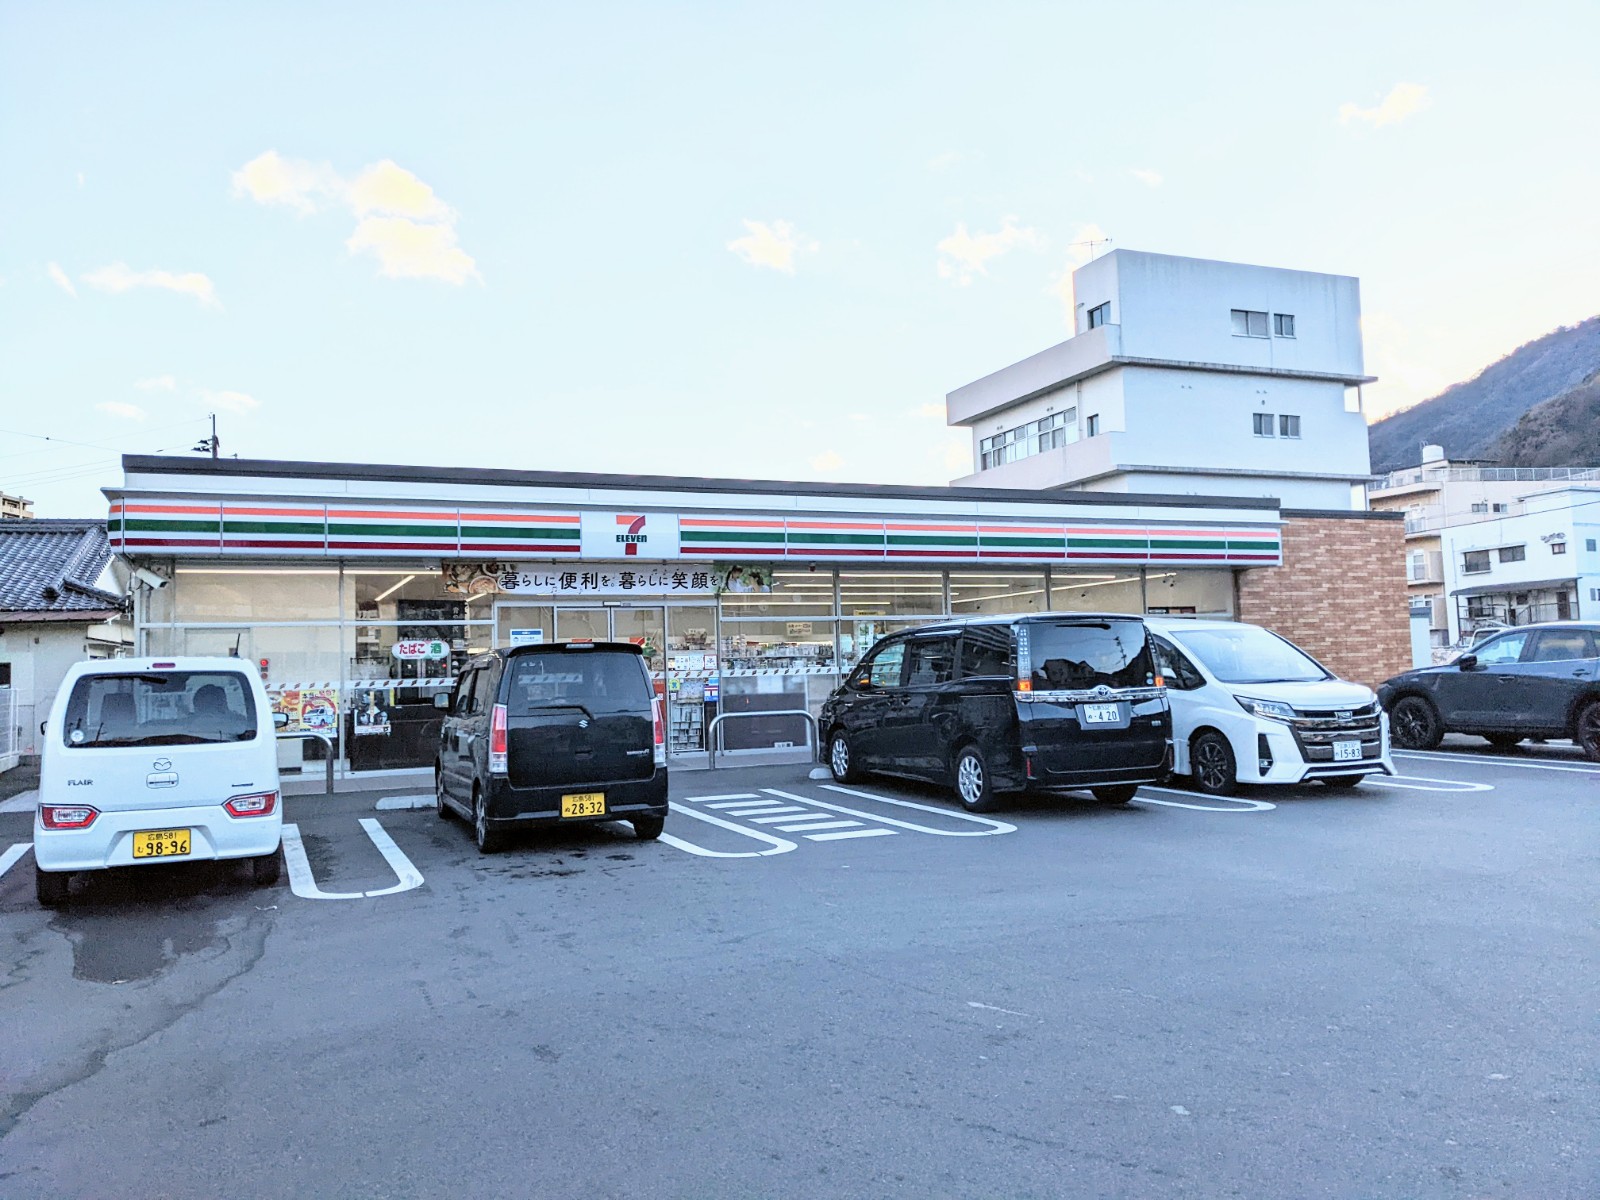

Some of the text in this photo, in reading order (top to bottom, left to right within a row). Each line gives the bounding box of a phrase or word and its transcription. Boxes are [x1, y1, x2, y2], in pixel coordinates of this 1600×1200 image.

[616, 515, 646, 555] 7
[399, 642, 442, 654] たばこ 酒
[1340, 748, 1360, 758] 15-83
[146, 840, 187, 856] 98-96
